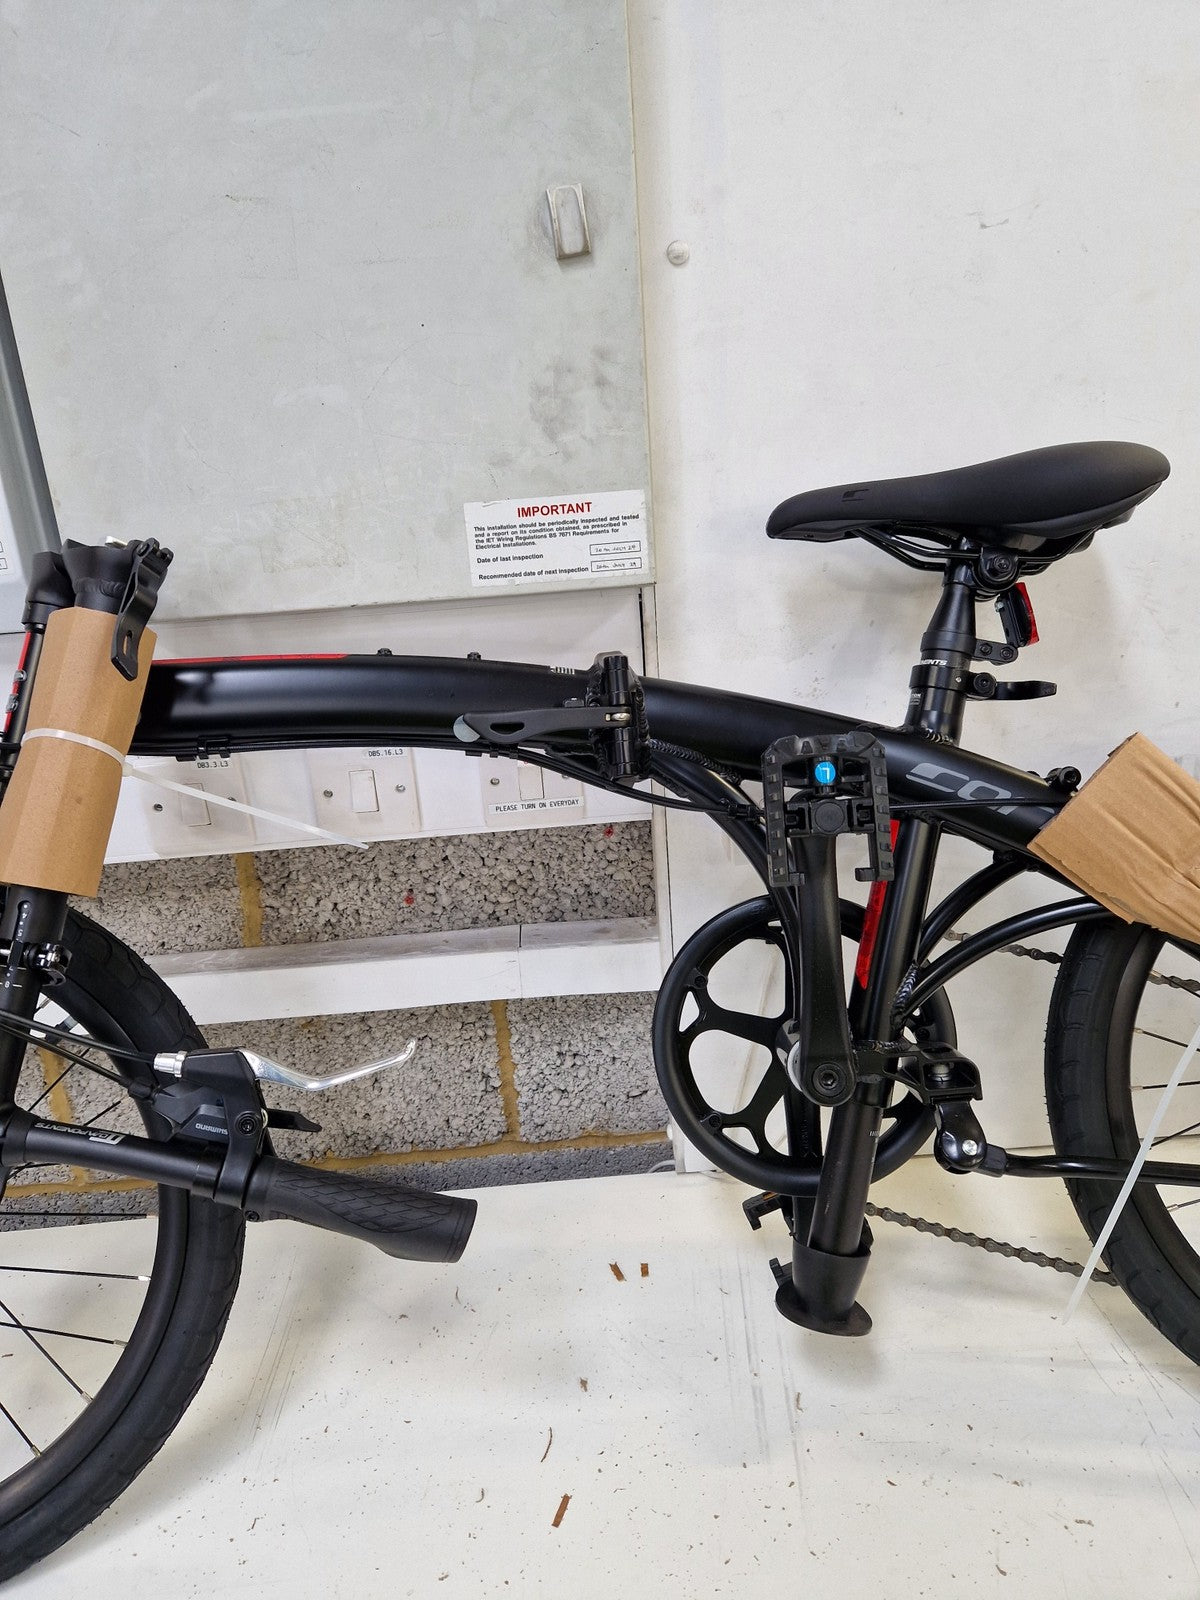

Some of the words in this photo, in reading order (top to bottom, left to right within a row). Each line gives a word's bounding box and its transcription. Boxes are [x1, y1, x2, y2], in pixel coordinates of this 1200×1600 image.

[517, 502, 592, 518] IMPORTANT
[547, 519, 579, 527] periodically
[581, 516, 607, 524] inspected
[515, 533, 547, 541] Regulations
[572, 528, 610, 537] Requirements
[475, 542, 501, 550] Electrical
[512, 553, 544, 562] inspection
[478, 571, 522, 580] Recommended
[558, 566, 589, 574] inspection
[495, 804, 518, 812] PLEASE
[521, 802, 536, 810] TURN
[549, 799, 580, 808] EVERYDAY
